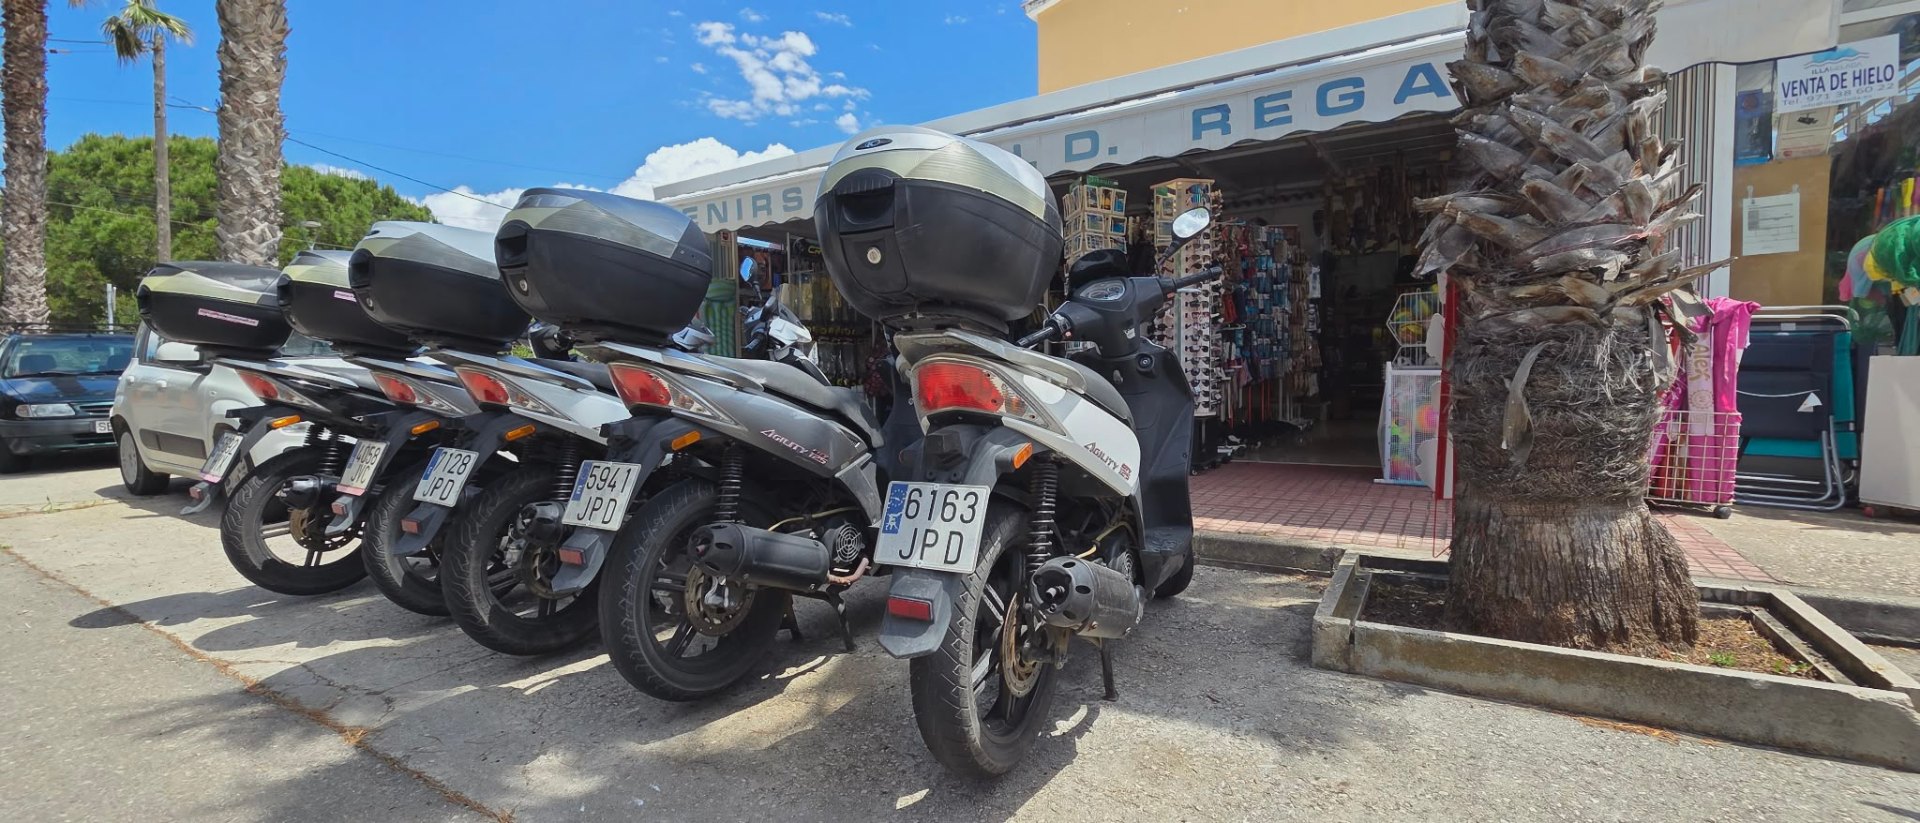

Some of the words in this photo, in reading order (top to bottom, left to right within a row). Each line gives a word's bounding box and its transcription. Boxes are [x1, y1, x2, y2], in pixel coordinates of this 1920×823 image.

[1781, 76, 1826, 98] VENTA
[1830, 72, 1848, 91] DE
[1852, 64, 1895, 88] HIELO
[1192, 62, 1452, 141] REGA
[356, 444, 381, 465] 4058
[760, 429, 809, 454] AGILITY
[1084, 441, 1119, 470] AGILITY
[433, 451, 472, 475] 7128
[422, 476, 455, 501] JPD
[586, 465, 632, 493] 5941
[577, 496, 618, 525] JPD
[905, 487, 979, 524] 6163
[898, 527, 964, 565] JPD
